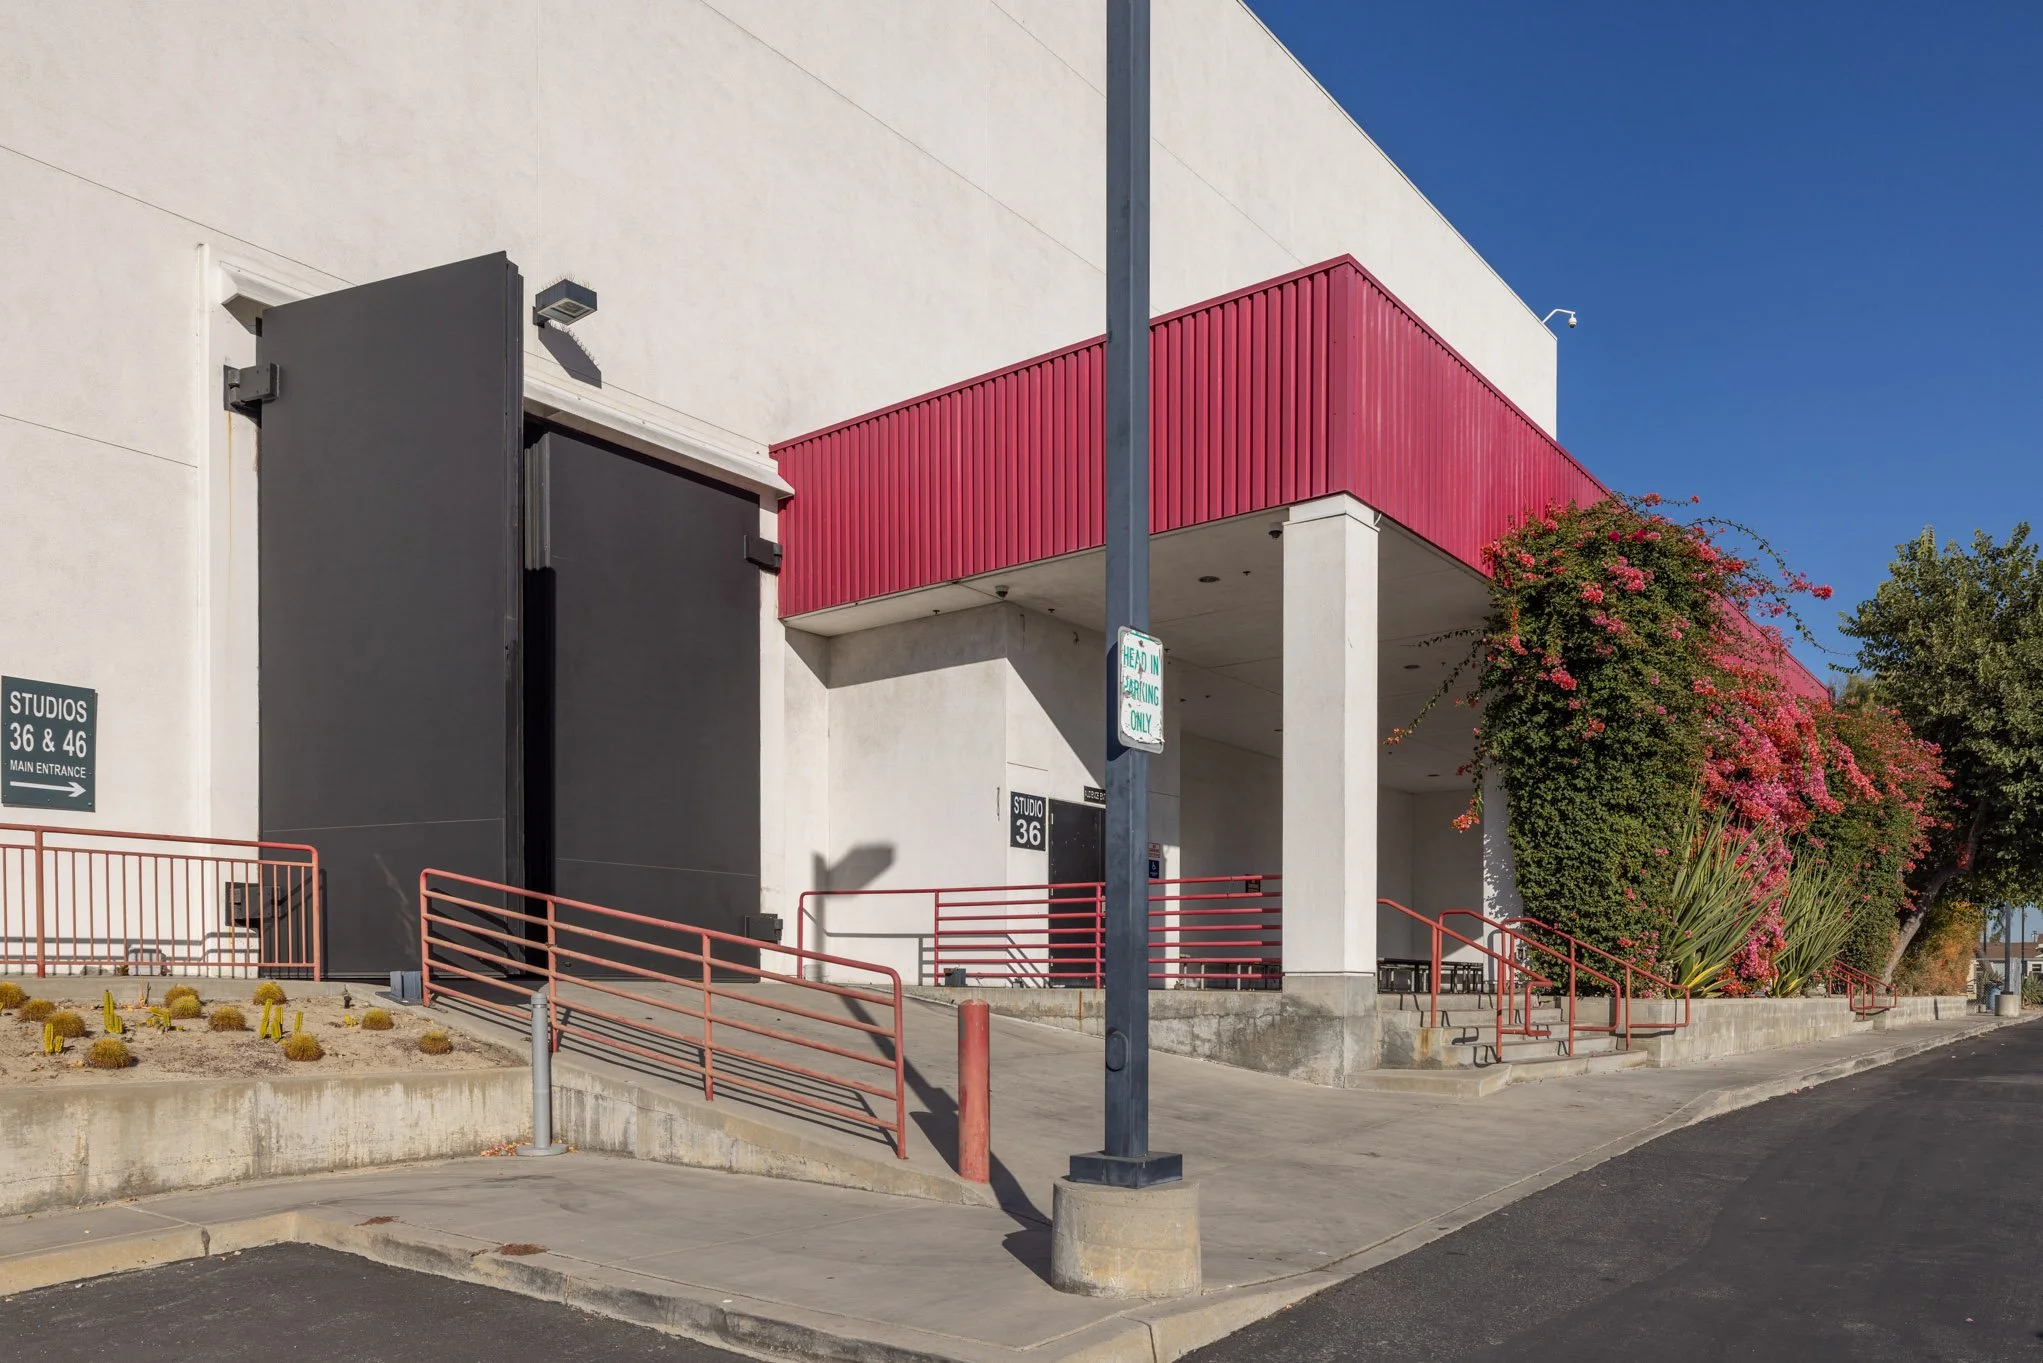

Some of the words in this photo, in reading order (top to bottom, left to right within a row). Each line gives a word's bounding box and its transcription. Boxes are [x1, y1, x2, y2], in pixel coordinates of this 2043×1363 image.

[1123, 645, 1147, 673] HEAD
[1150, 654, 1159, 676] IN
[10, 691, 87, 723] STUDIOS
[1130, 710, 1152, 734] ONLY
[10, 722, 34, 752] 36
[42, 728, 55, 752] &
[63, 729, 87, 758] 46
[10, 759, 34, 773] MAIN
[36, 762, 87, 779] ENTRANCE
[1013, 796, 1043, 818] STUDIO
[1015, 818, 1041, 846] 36
